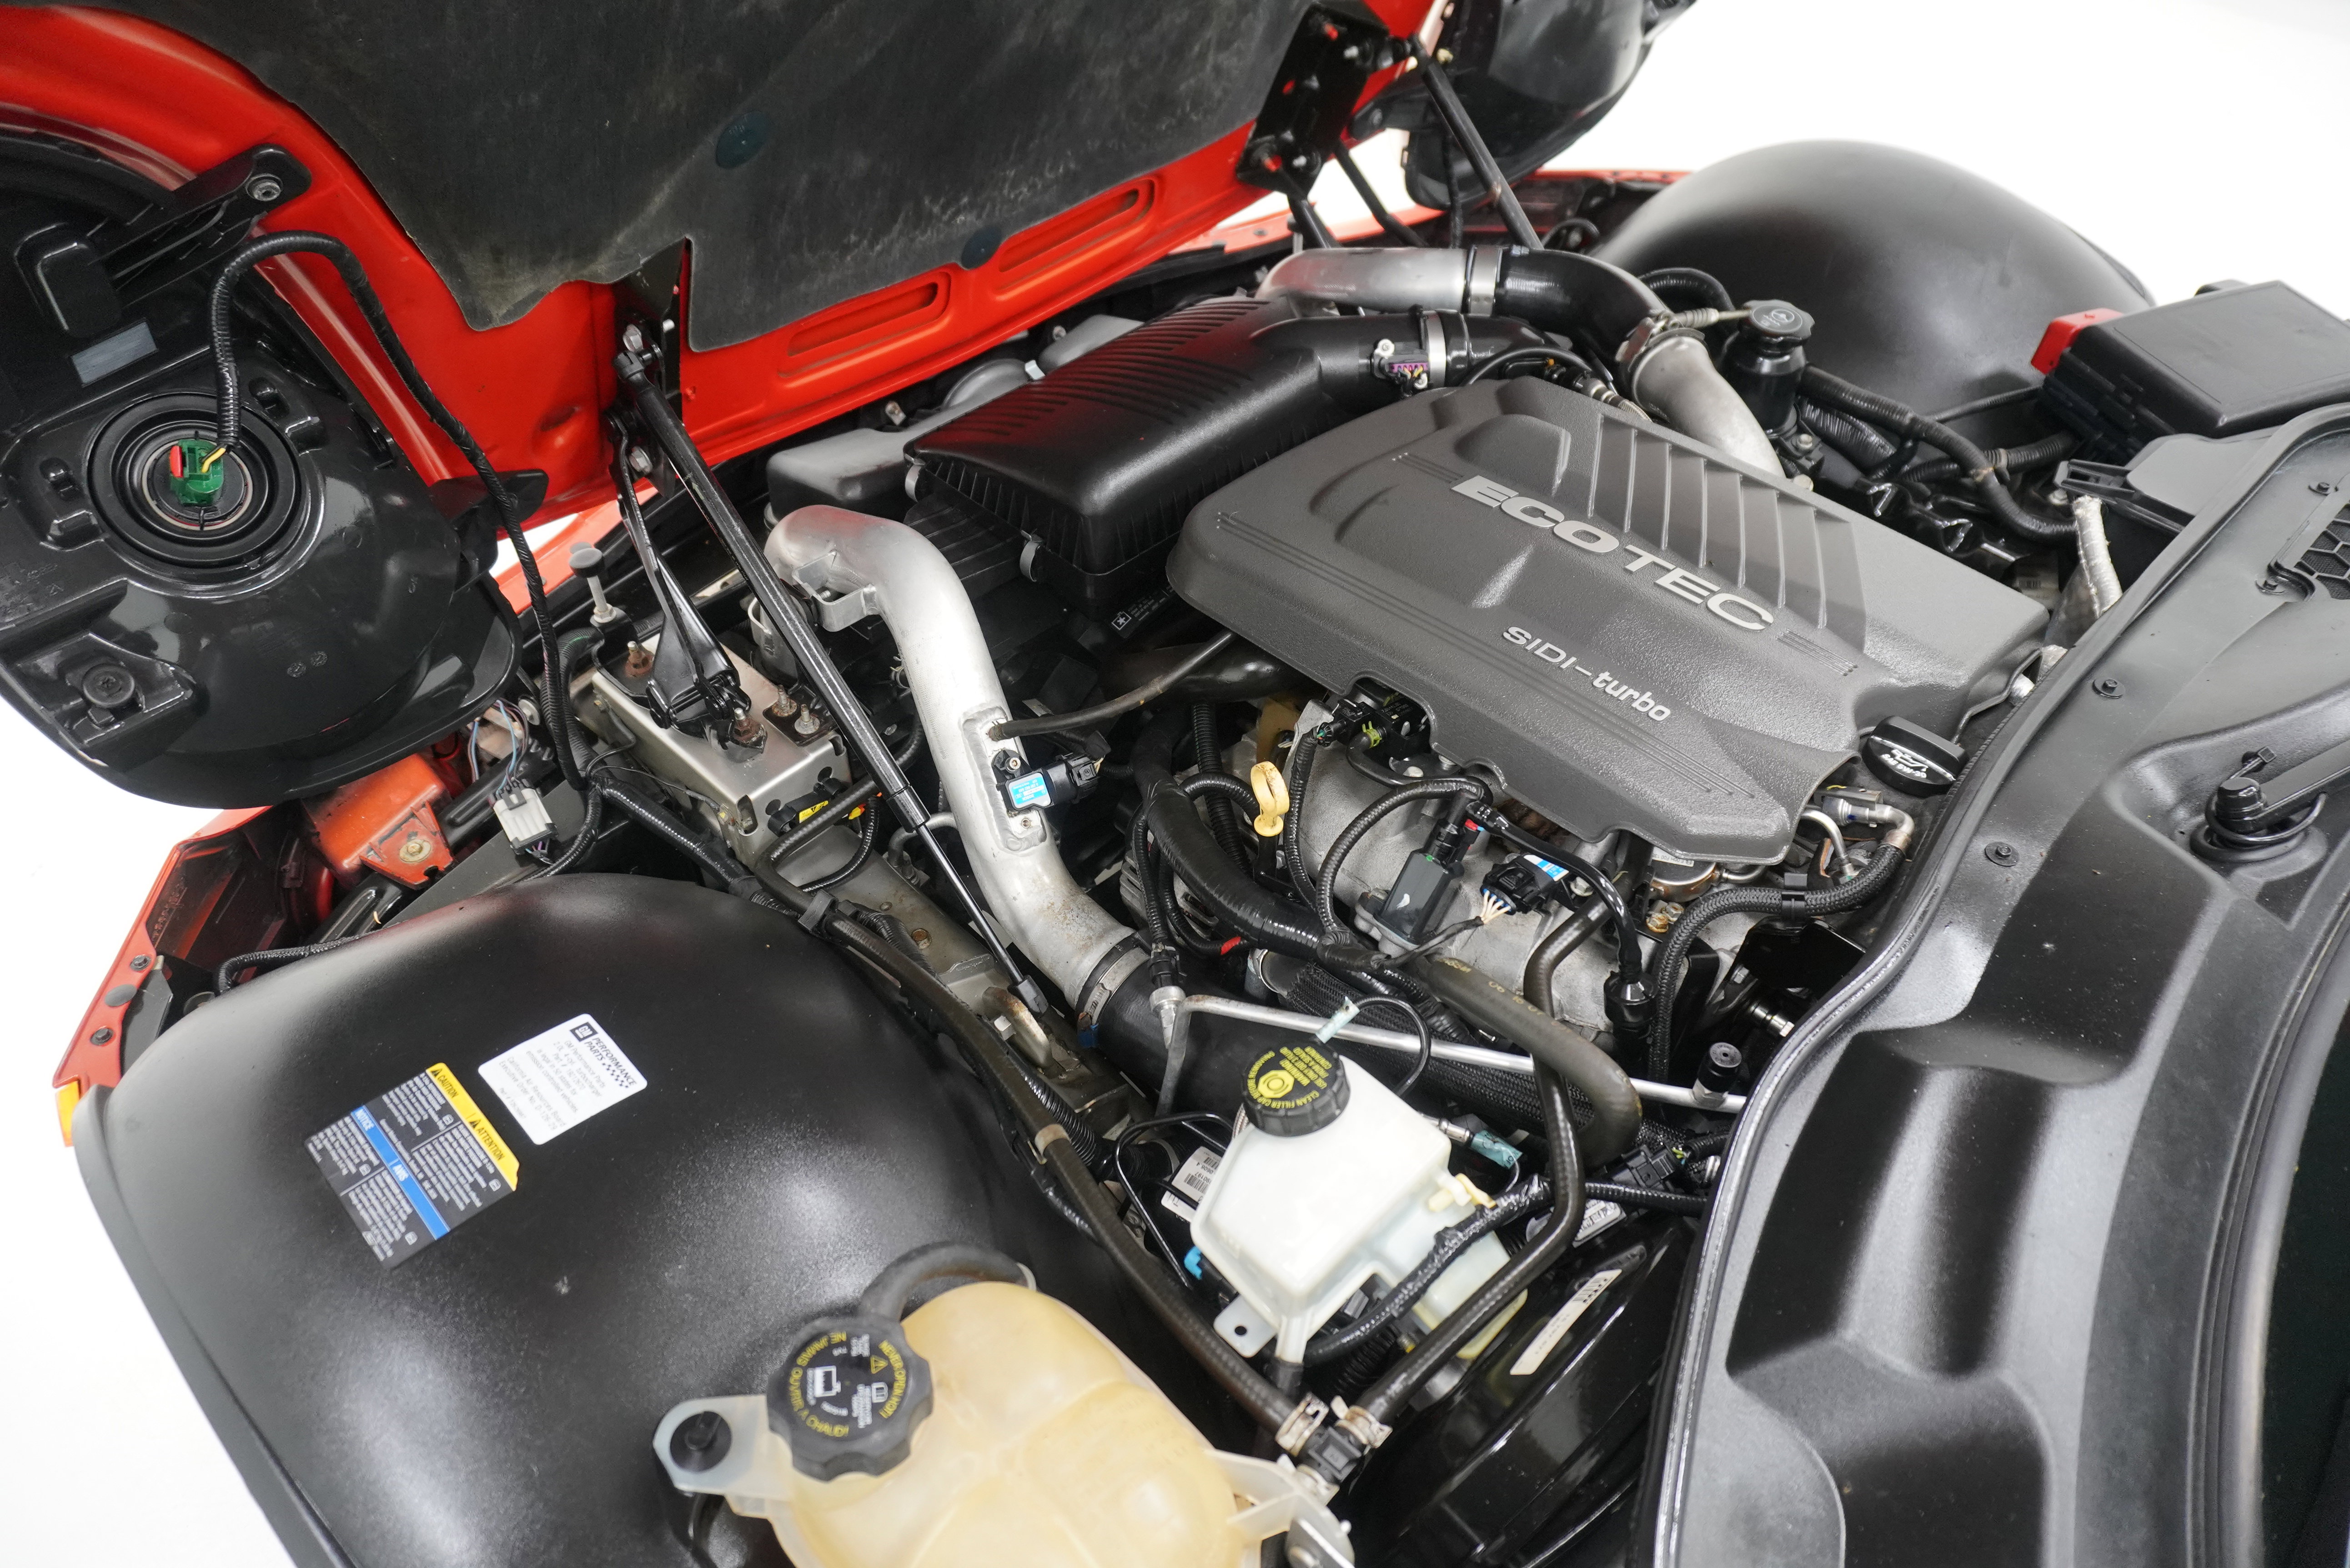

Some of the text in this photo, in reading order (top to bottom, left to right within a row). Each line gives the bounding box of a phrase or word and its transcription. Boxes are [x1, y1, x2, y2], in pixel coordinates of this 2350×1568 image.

[1451, 475, 1774, 631] ECOTEC
[1503, 626, 1671, 722] SIDI-turbo
[1880, 754, 1927, 778] SAE 5W-30
[552, 1052, 563, 1063] Part
[584, 1040, 604, 1061] PARTS
[592, 1037, 636, 1086] PERFORMANCE
[1280, 1046, 1296, 1060] FLUID
[1293, 1046, 1313, 1064] SEALED
[1304, 1046, 1332, 1070] CONTAINER
[498, 1061, 520, 1083] Executive
[516, 1082, 530, 1096] Order
[525, 1050, 545, 1070] emission
[542, 1070, 563, 1092] controlled
[540, 1053, 552, 1064] legal
[558, 1075, 572, 1089] states
[571, 1047, 597, 1075] Performance
[593, 1075, 606, 1088] Parts
[1247, 1050, 1320, 1109] CLEAN FILLER CAP BEFORE REMOVING
[1279, 1058, 1311, 1086] WARNING!
[1302, 1067, 1319, 1081] ONLY
[1311, 1064, 1329, 1079] FROM
[437, 1074, 458, 1098] CAUTION
[507, 1056, 528, 1079] California
[531, 1086, 553, 1111] Resources
[550, 1111, 567, 1127] Board
[575, 1068, 602, 1098] turbocharger
[1313, 1076, 1327, 1090] USE
[353, 1109, 374, 1131] NOTICE
[476, 1127, 505, 1161] ATTENTION
[392, 1163, 409, 1181] AVIS
[797, 1335, 829, 1366] JAMAIS
[829, 1331, 847, 1344] NE
[878, 1340, 904, 1368] NEVER
[893, 1367, 906, 1396] OPEN
[789, 1367, 805, 1412] OUVRIR
